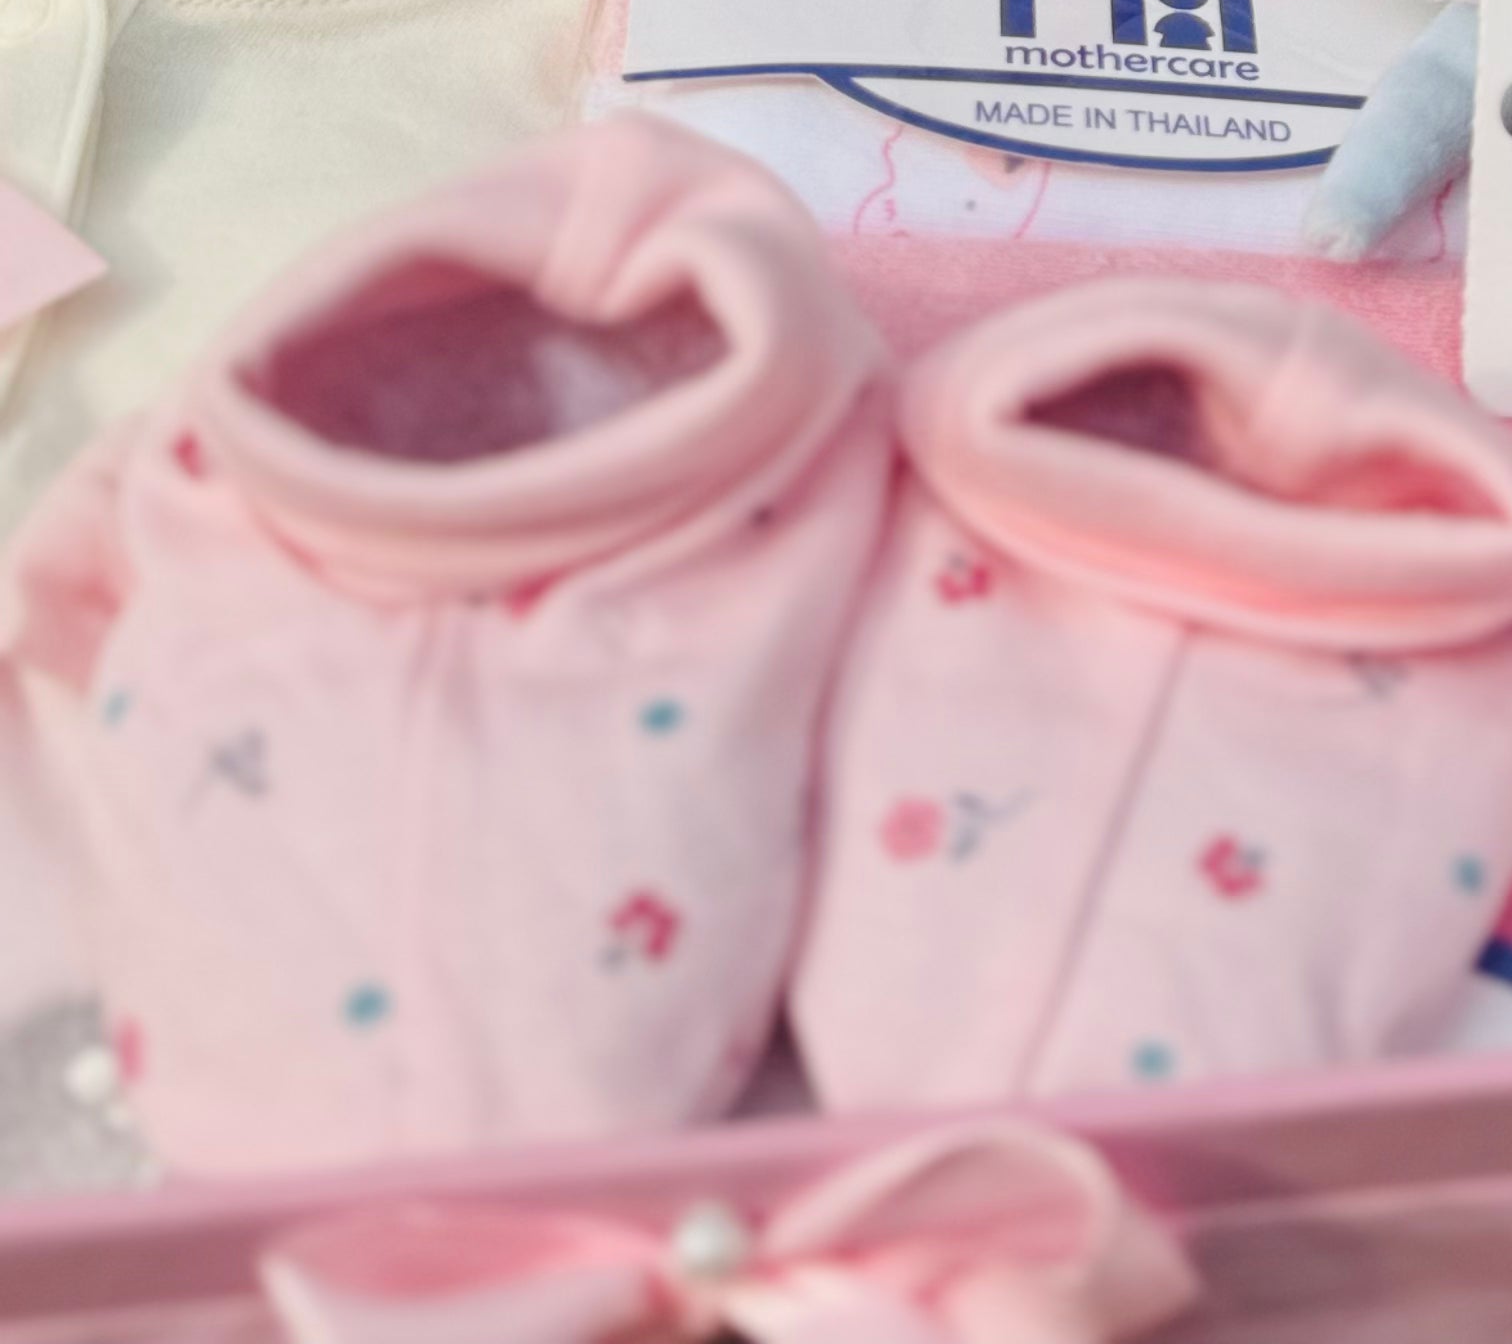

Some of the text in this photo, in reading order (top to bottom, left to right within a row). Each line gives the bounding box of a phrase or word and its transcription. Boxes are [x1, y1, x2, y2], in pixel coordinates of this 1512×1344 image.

[1005, 44, 1260, 80] mothercare
[974, 99, 1293, 144] MADE IN THAILAND
